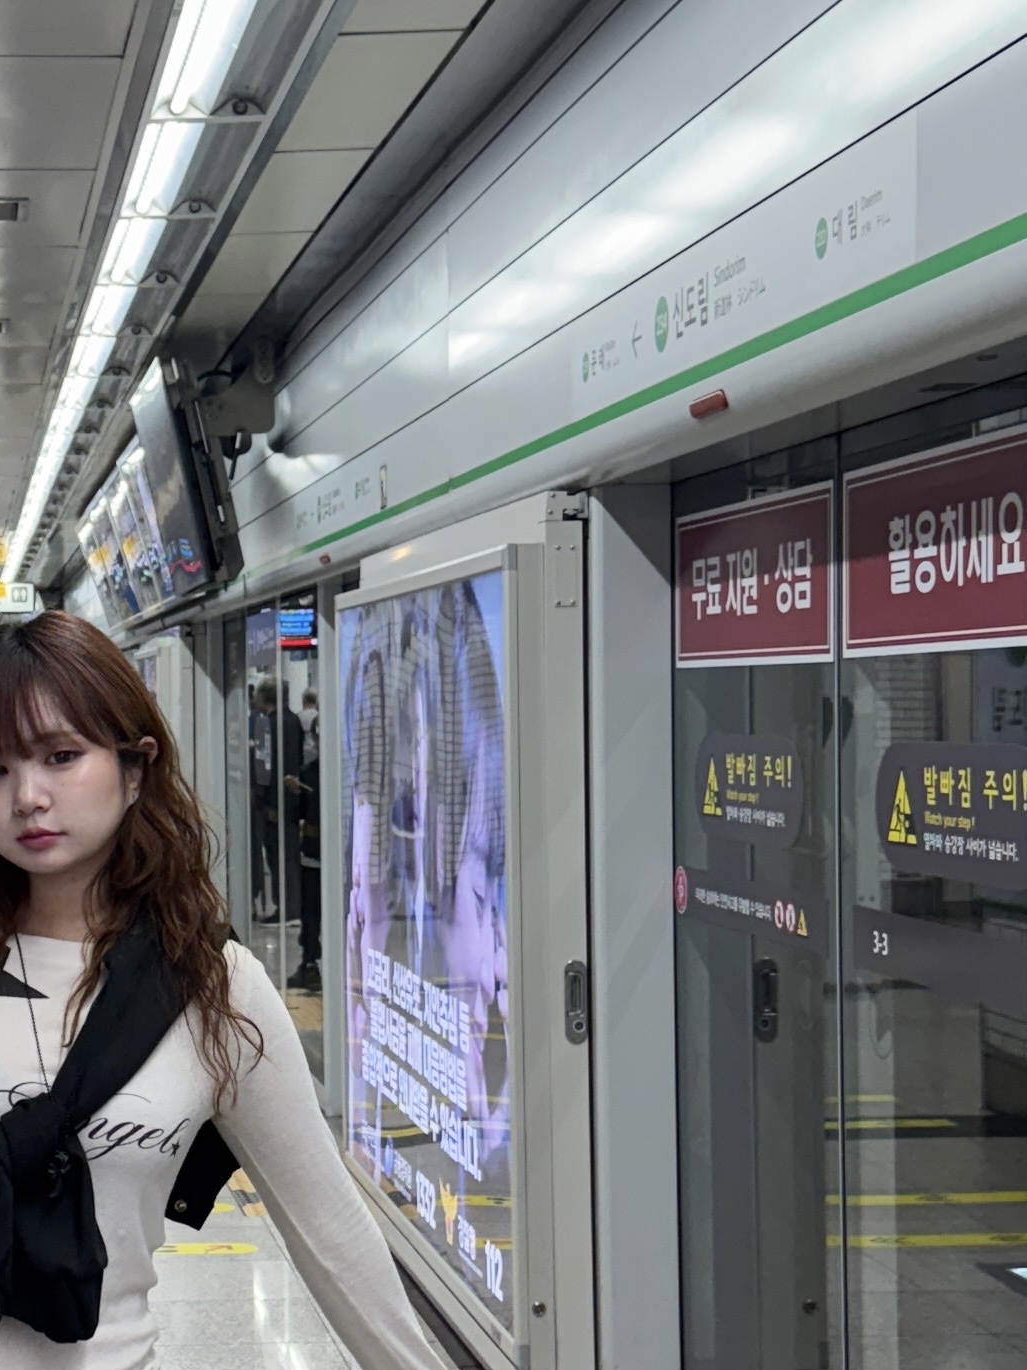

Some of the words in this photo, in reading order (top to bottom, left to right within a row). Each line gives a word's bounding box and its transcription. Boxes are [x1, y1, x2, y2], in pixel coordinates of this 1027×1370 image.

[672, 271, 710, 340] 신도림
[887, 491, 1026, 596] 활용하세요
[691, 555, 722, 621] 무료
[725, 547, 759, 617] 지원
[774, 537, 813, 614] 상담
[725, 752, 757, 787] 발빠짐
[763, 755, 792, 789] 주의!
[923, 765, 972, 809] 발빠짐
[944, 834, 965, 856] 승강장
[872, 930, 889, 956] 3-3
[367, 948, 392, 1005] 고금리,
[423, 979, 458, 1048] 지인추심
[484, 1239, 504, 1303] 112
